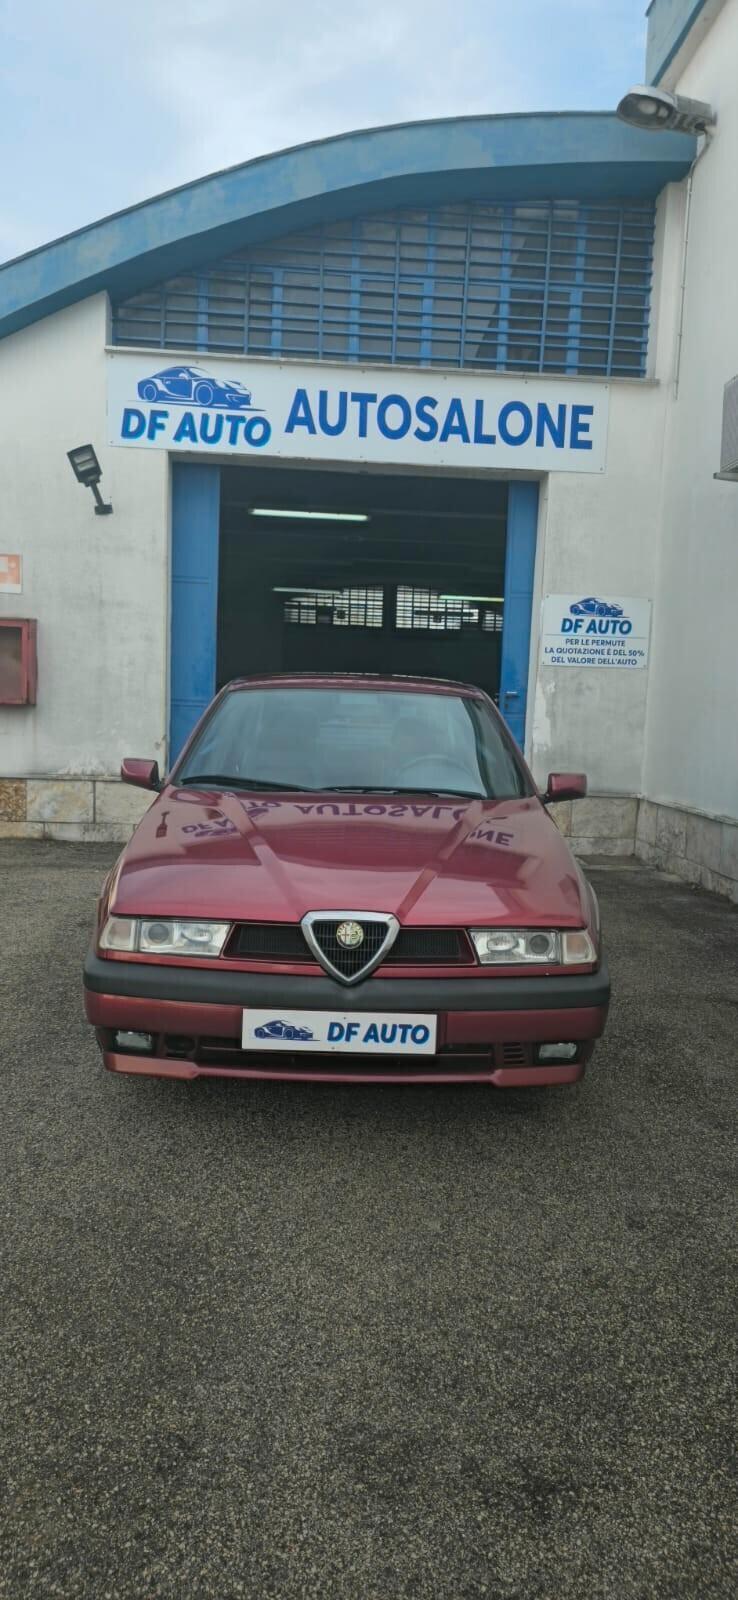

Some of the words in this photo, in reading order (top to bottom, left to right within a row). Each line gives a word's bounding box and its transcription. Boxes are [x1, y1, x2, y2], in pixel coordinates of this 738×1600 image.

[121, 408, 169, 441] DF
[173, 412, 272, 447] AUTO
[284, 388, 595, 450] AUTOSALONE
[561, 618, 584, 634] DF
[586, 619, 632, 635] AUTO
[565, 638, 580, 646] PER
[591, 639, 626, 647] PERMUTE
[556, 647, 605, 656] QUOTAZIONE
[567, 657, 596, 665] VALORE
[597, 657, 638, 666] DELL'AUTO
[327, 1022, 360, 1042] DF
[362, 1023, 430, 1045] AUTO
